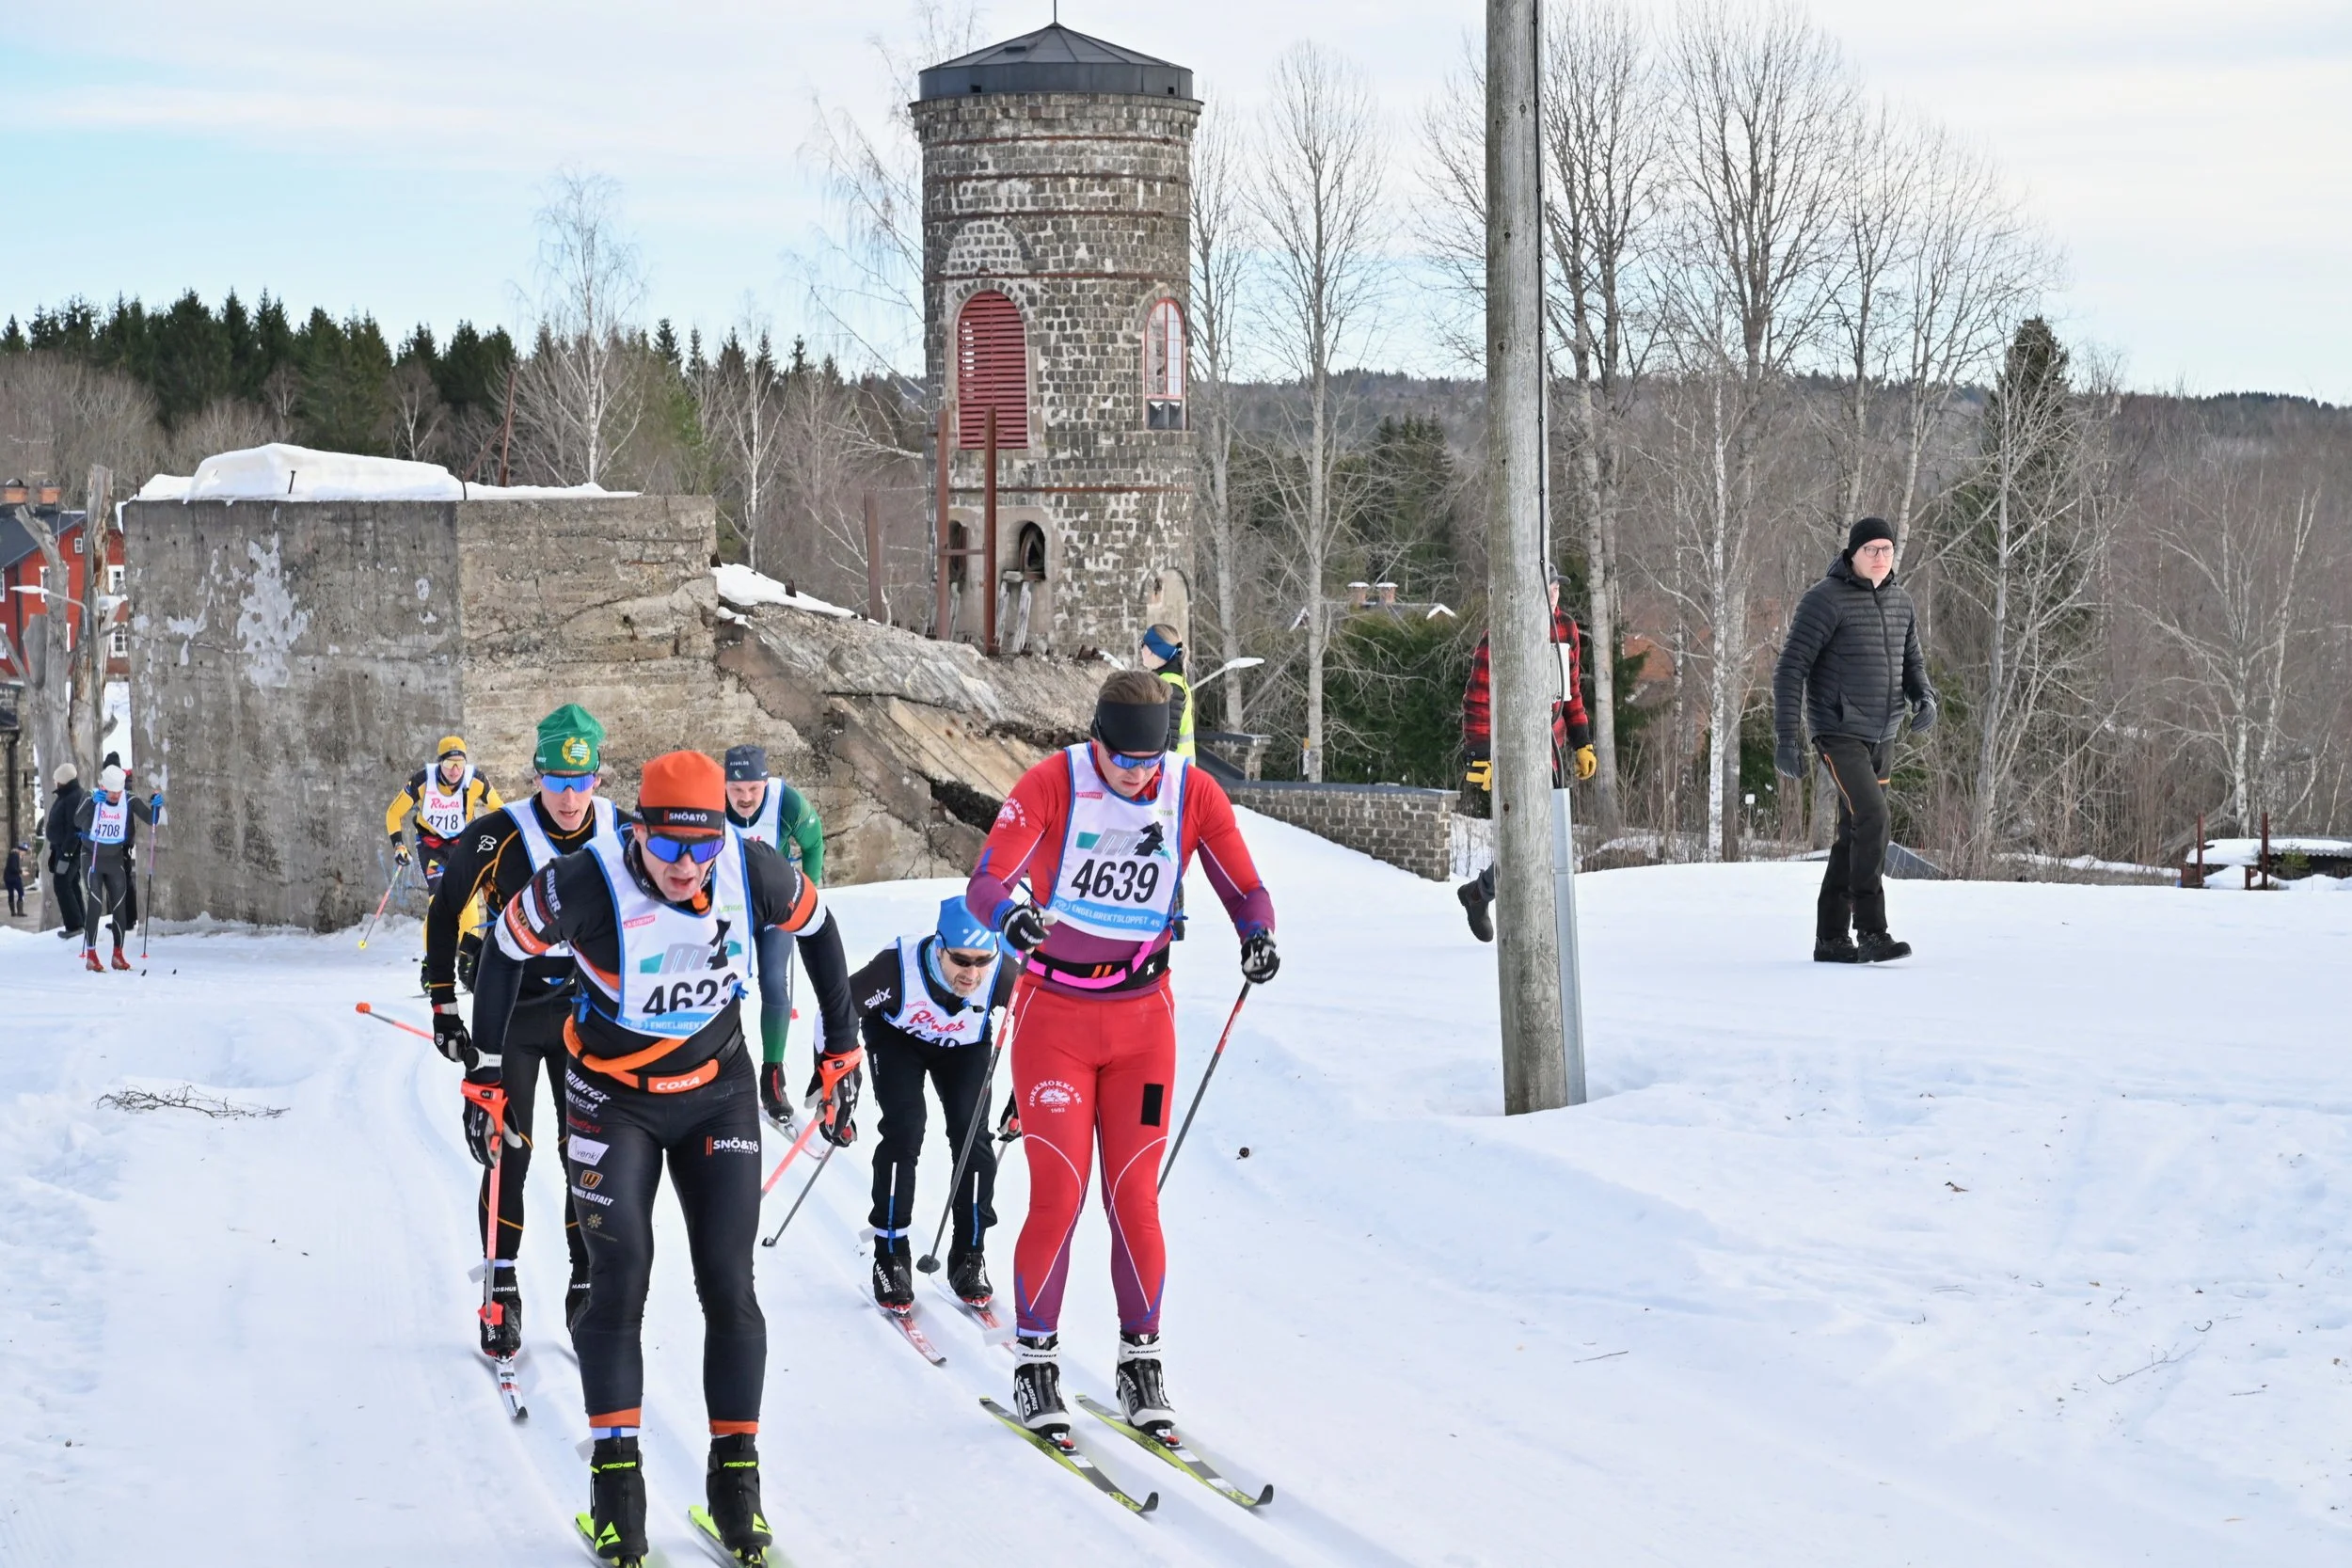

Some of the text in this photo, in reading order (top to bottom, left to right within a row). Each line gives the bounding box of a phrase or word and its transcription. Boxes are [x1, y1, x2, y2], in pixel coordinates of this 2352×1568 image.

[427, 815, 458, 830] 4718
[669, 812, 707, 822] SNÖ&TÖ
[1071, 858, 1159, 903] 4639
[546, 868, 562, 912] SILVER
[657, 1076, 700, 1090] COXA
[1029, 1080, 1074, 1107] JOKKMOKKS
[712, 1136, 759, 1153] SNÖ&TÖ
[585, 1190, 614, 1207] ASFALT
[874, 1263, 893, 1293] MADSHUS
[601, 1461, 637, 1469] FISCHER
